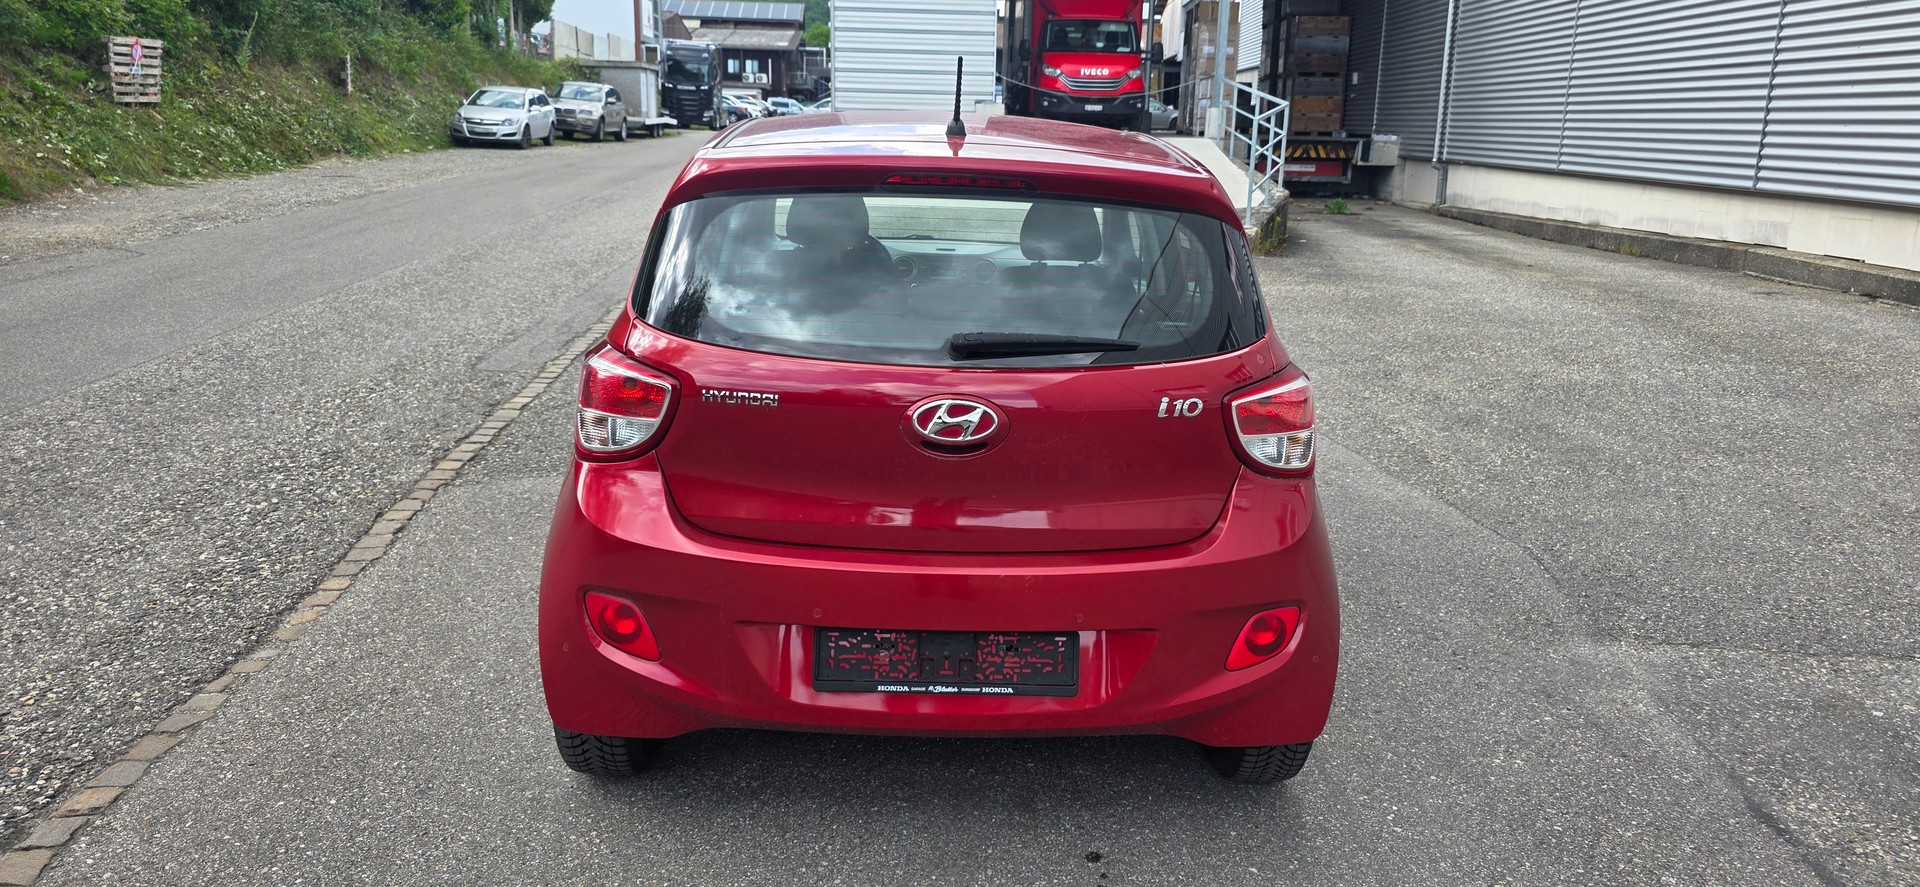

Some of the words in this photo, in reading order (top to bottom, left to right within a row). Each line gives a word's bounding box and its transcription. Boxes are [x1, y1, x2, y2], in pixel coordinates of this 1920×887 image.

[1080, 67, 1110, 76] IVECO
[702, 389, 778, 407] HYUNDAI
[1157, 396, 1204, 418] i10
